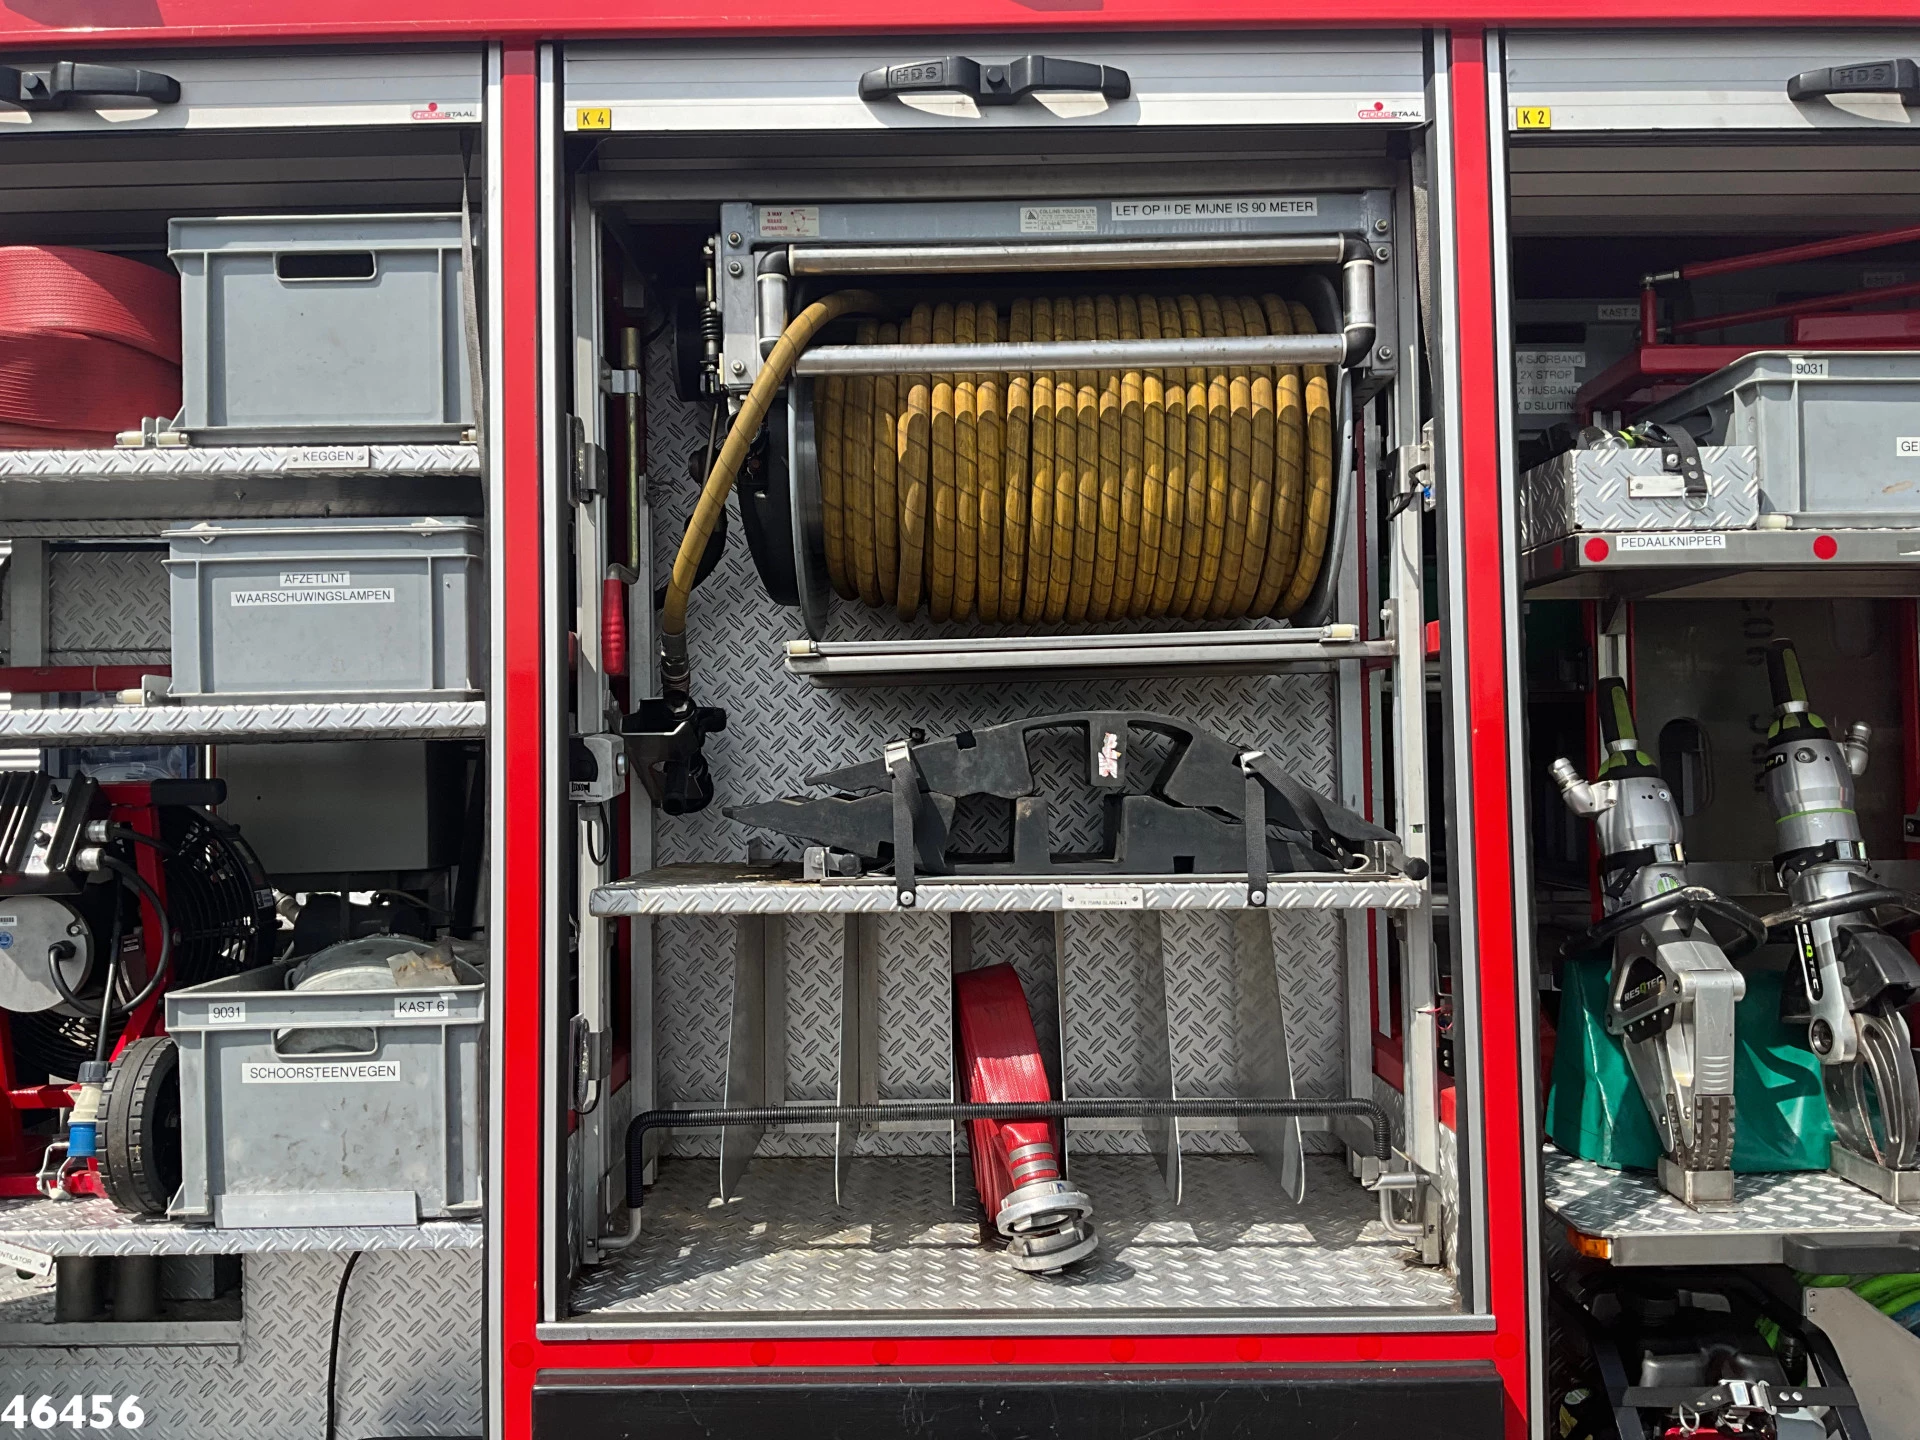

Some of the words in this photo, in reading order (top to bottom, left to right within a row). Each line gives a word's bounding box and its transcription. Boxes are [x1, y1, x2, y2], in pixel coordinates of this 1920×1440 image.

[896, 66, 937, 82] HDS
[1840, 68, 1886, 84] HDS
[413, 110, 476, 120] HOOGSTAAL
[582, 111, 590, 125] K
[597, 111, 605, 125] 4
[1361, 110, 1422, 119] HOOGSTAAL
[1523, 110, 1531, 124] K
[1538, 110, 1545, 124] 2
[1116, 205, 1138, 216] LET
[1141, 204, 1160, 215] OP
[1164, 204, 1171, 215] !!
[1174, 203, 1191, 215] DE
[1195, 202, 1233, 214] MIJNE
[1236, 202, 1249, 213] IS
[1252, 202, 1266, 213] 90
[1269, 201, 1314, 212] METER
[1601, 308, 1628, 317] KAST
[1631, 308, 1638, 317] 2
[1526, 355, 1583, 364] SJORBAND
[1520, 370, 1532, 379] 2X
[1536, 370, 1572, 380] STROP
[1795, 363, 1823, 375] 9031
[1524, 401, 1532, 411] D
[1534, 401, 1574, 411] SLUITIN
[1901, 441, 1920, 452] GE
[302, 450, 354, 461] KEGGEN
[1621, 535, 1722, 548] PEDAALKNIPPER
[284, 573, 345, 584] AFZETLINT
[235, 590, 391, 603] WAARSCHUWINGSLAMPEN
[1801, 923, 1820, 992] ESQTEC
[1624, 974, 1663, 1002] RESQTEC
[213, 1006, 241, 1019] 9031
[399, 1001, 433, 1013] KAST
[436, 1000, 445, 1012] 6
[249, 1064, 396, 1079] SCHOORSTEENVEGEN
[0, 1251, 33, 1265] NTILATOR
